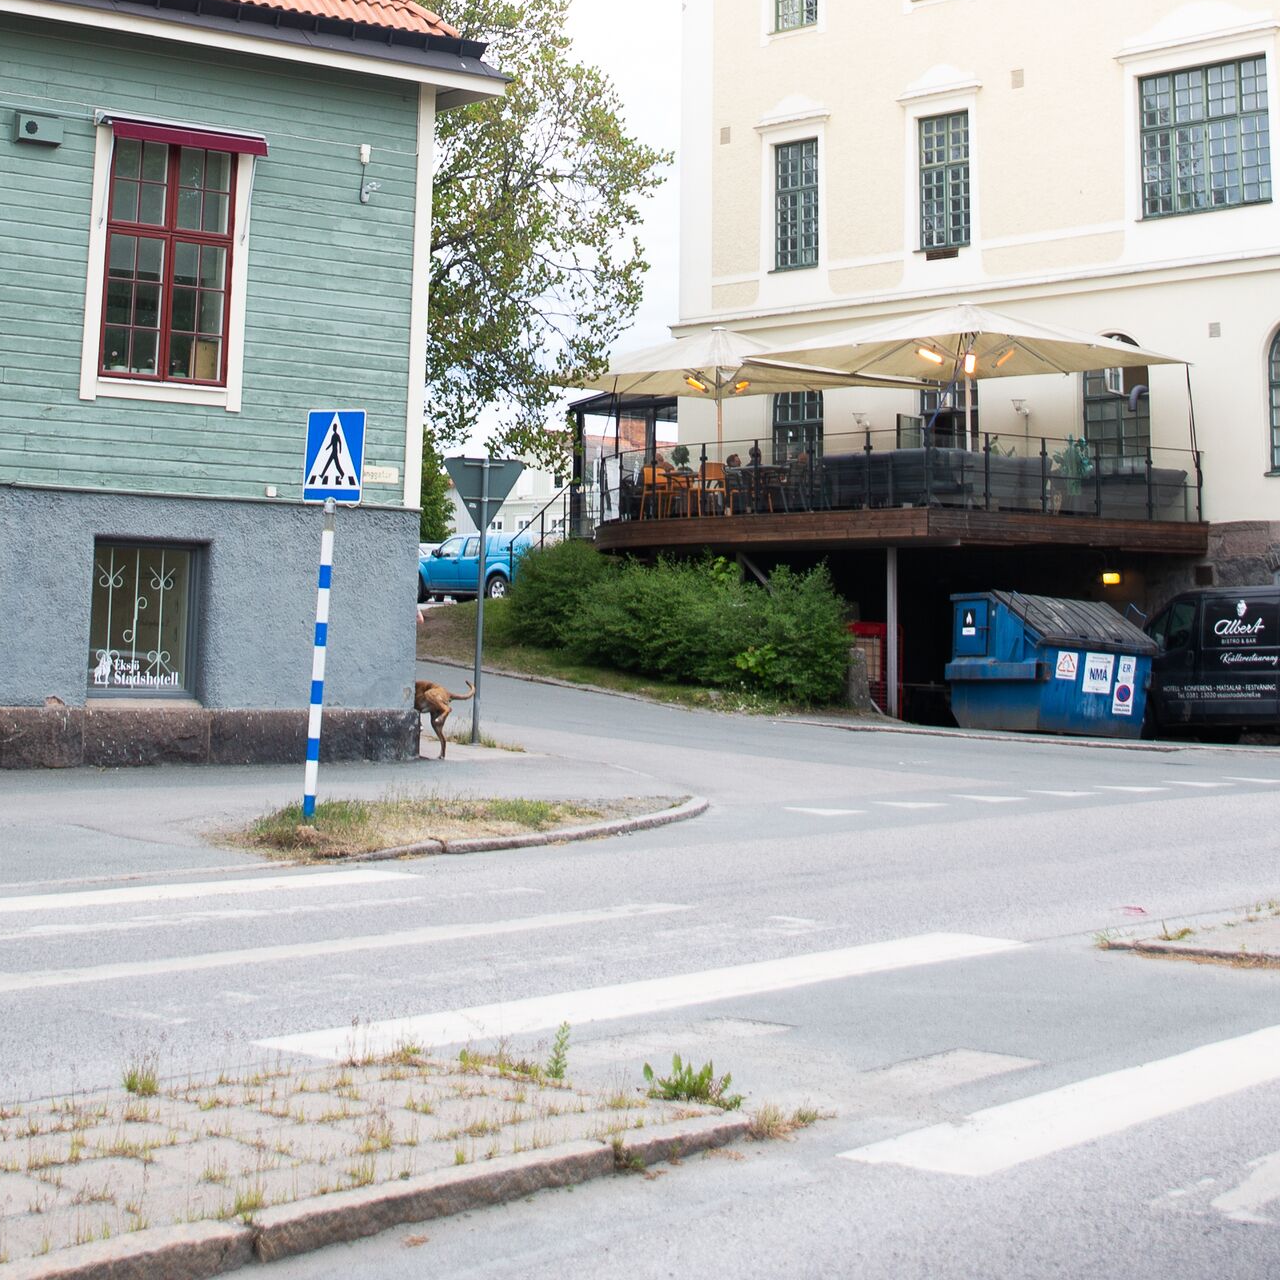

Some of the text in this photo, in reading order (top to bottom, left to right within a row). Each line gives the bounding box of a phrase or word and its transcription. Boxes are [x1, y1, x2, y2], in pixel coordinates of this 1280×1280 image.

[1214, 617, 1265, 635] Albert
[113, 659, 140, 674] Eksjö
[1220, 652, 1278, 666] Kvällsrestaurang
[113, 670, 179, 686] Stadshotell
[1184, 684, 1212, 692] KONFERENS
